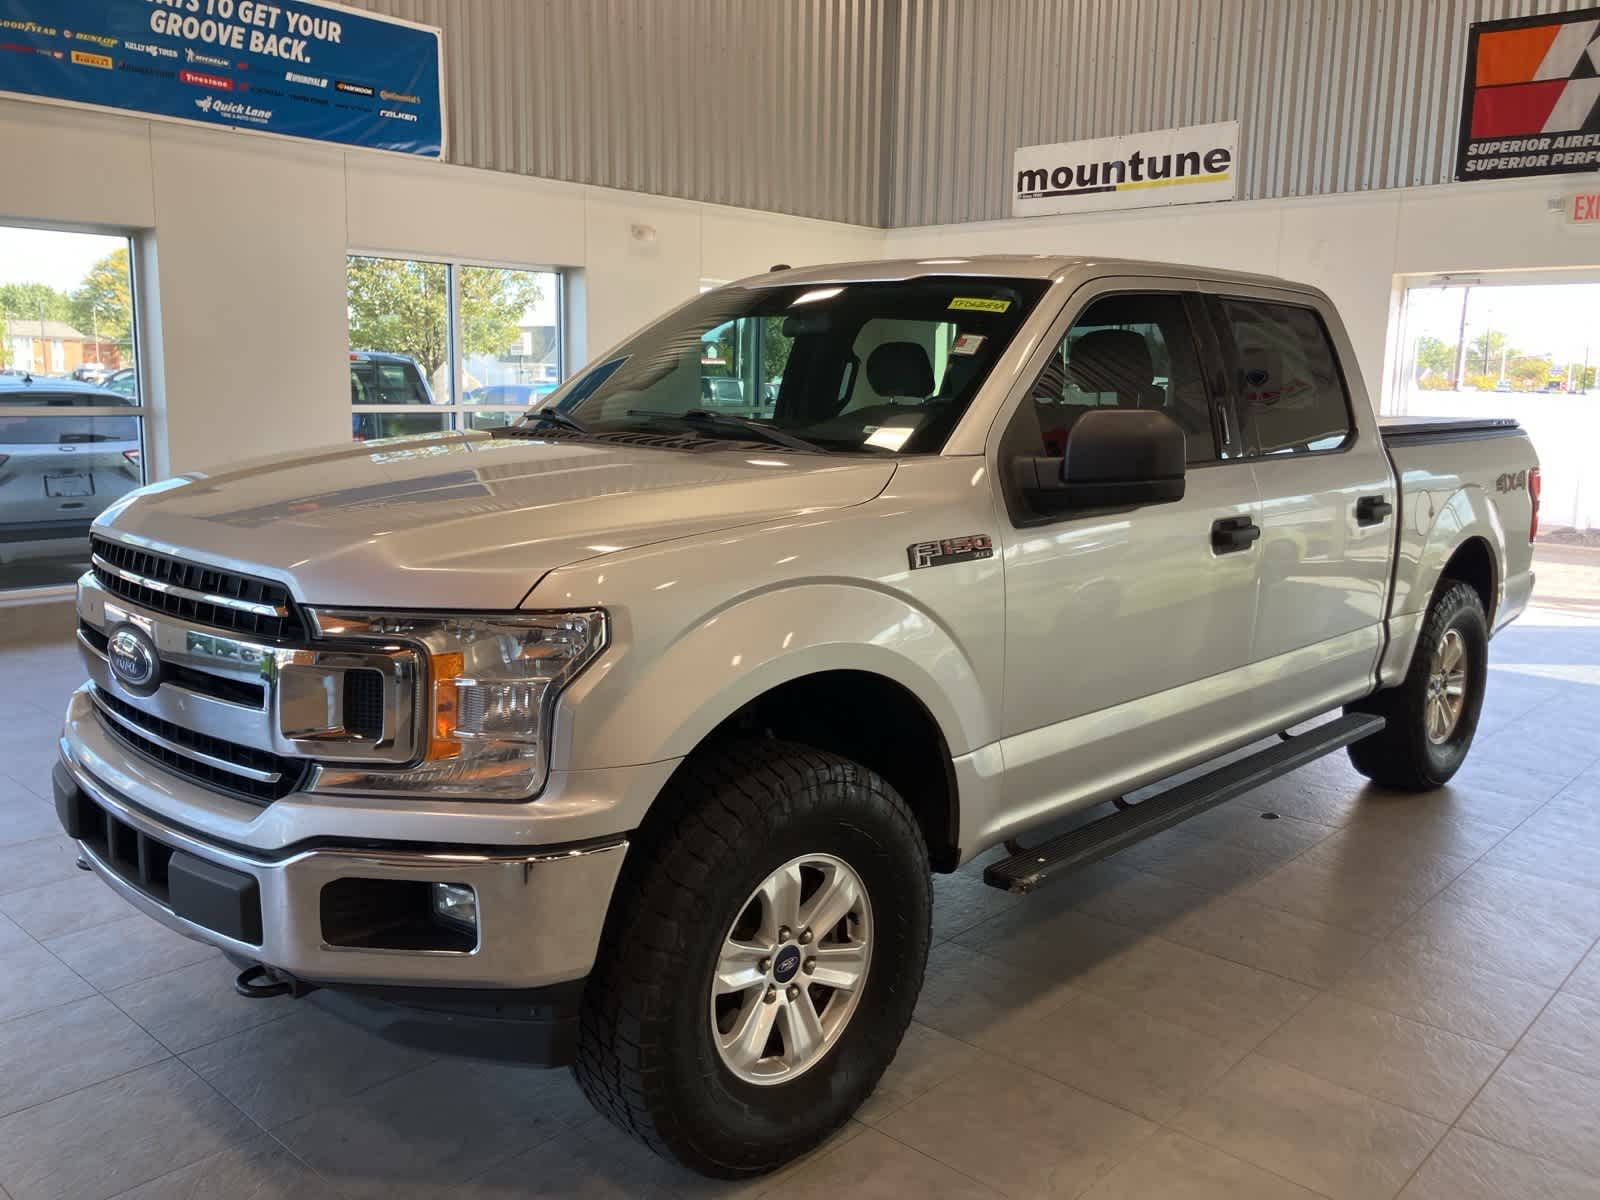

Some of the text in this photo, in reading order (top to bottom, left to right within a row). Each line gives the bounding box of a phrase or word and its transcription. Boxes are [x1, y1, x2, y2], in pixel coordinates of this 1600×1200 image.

[150, 9, 311, 63] GROOVE BACK.
[206, 0, 234, 19] TO
[238, 0, 281, 29] GET
[286, 11, 342, 43] YOUR
[212, 99, 272, 120] Quick Lane
[1467, 137, 1551, 156] SUPERIOR
[1017, 148, 1231, 193] mountune
[1465, 154, 1550, 172] SUPERIOR
